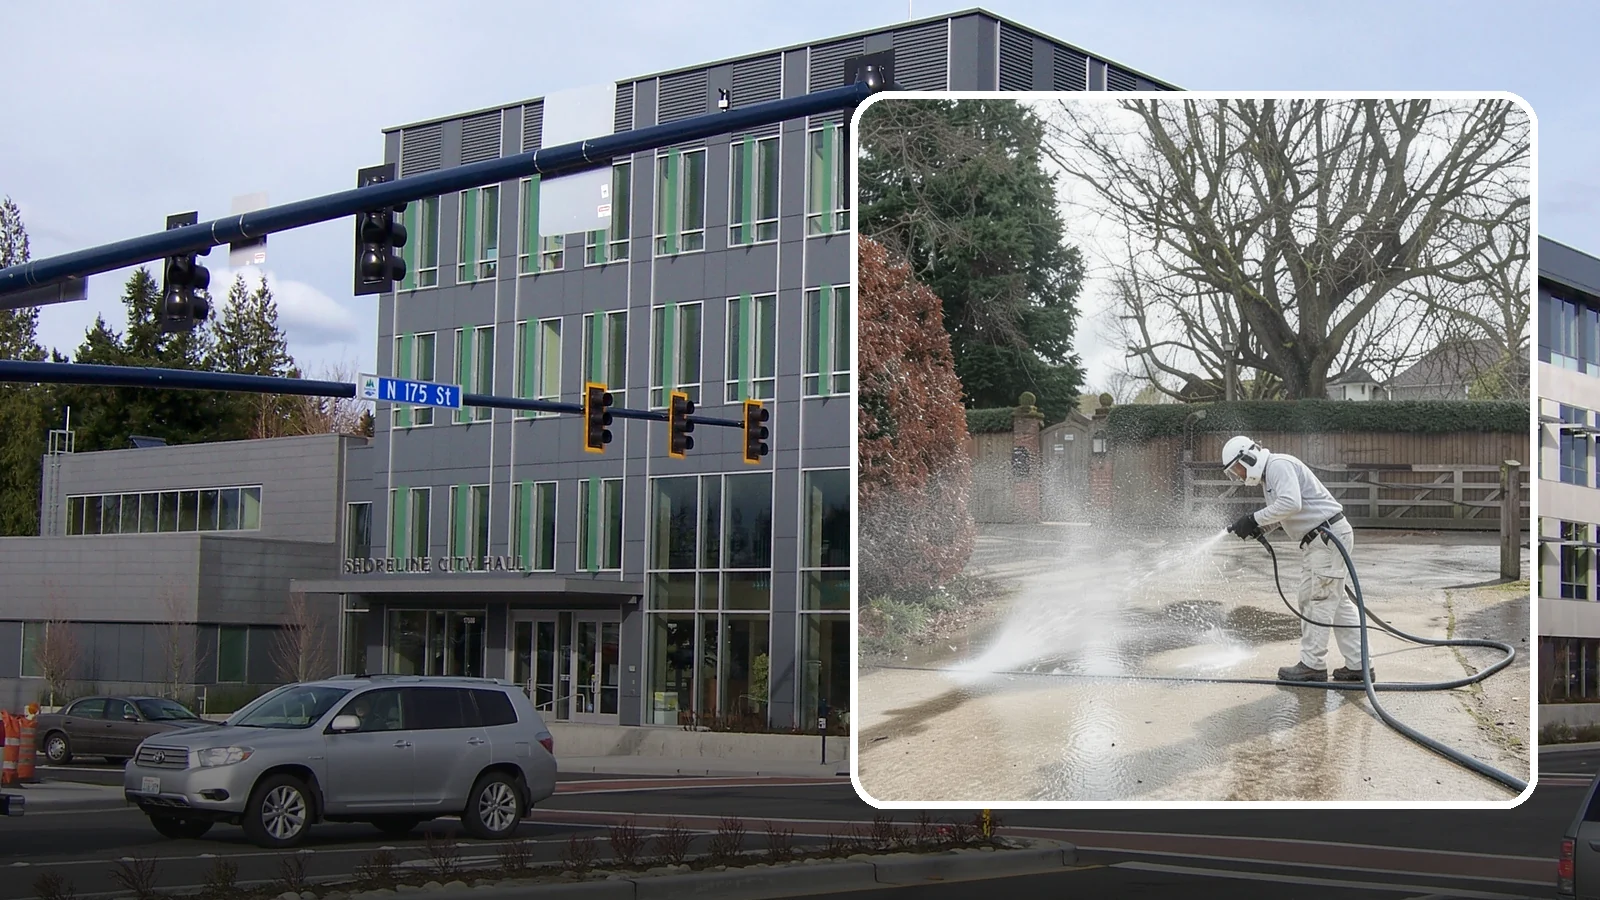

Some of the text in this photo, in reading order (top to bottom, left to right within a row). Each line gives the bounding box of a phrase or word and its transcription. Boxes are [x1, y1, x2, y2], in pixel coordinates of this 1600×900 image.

[387, 380, 451, 406] N 175 St
[344, 556, 525, 574] SHORELINE CITY HALL
